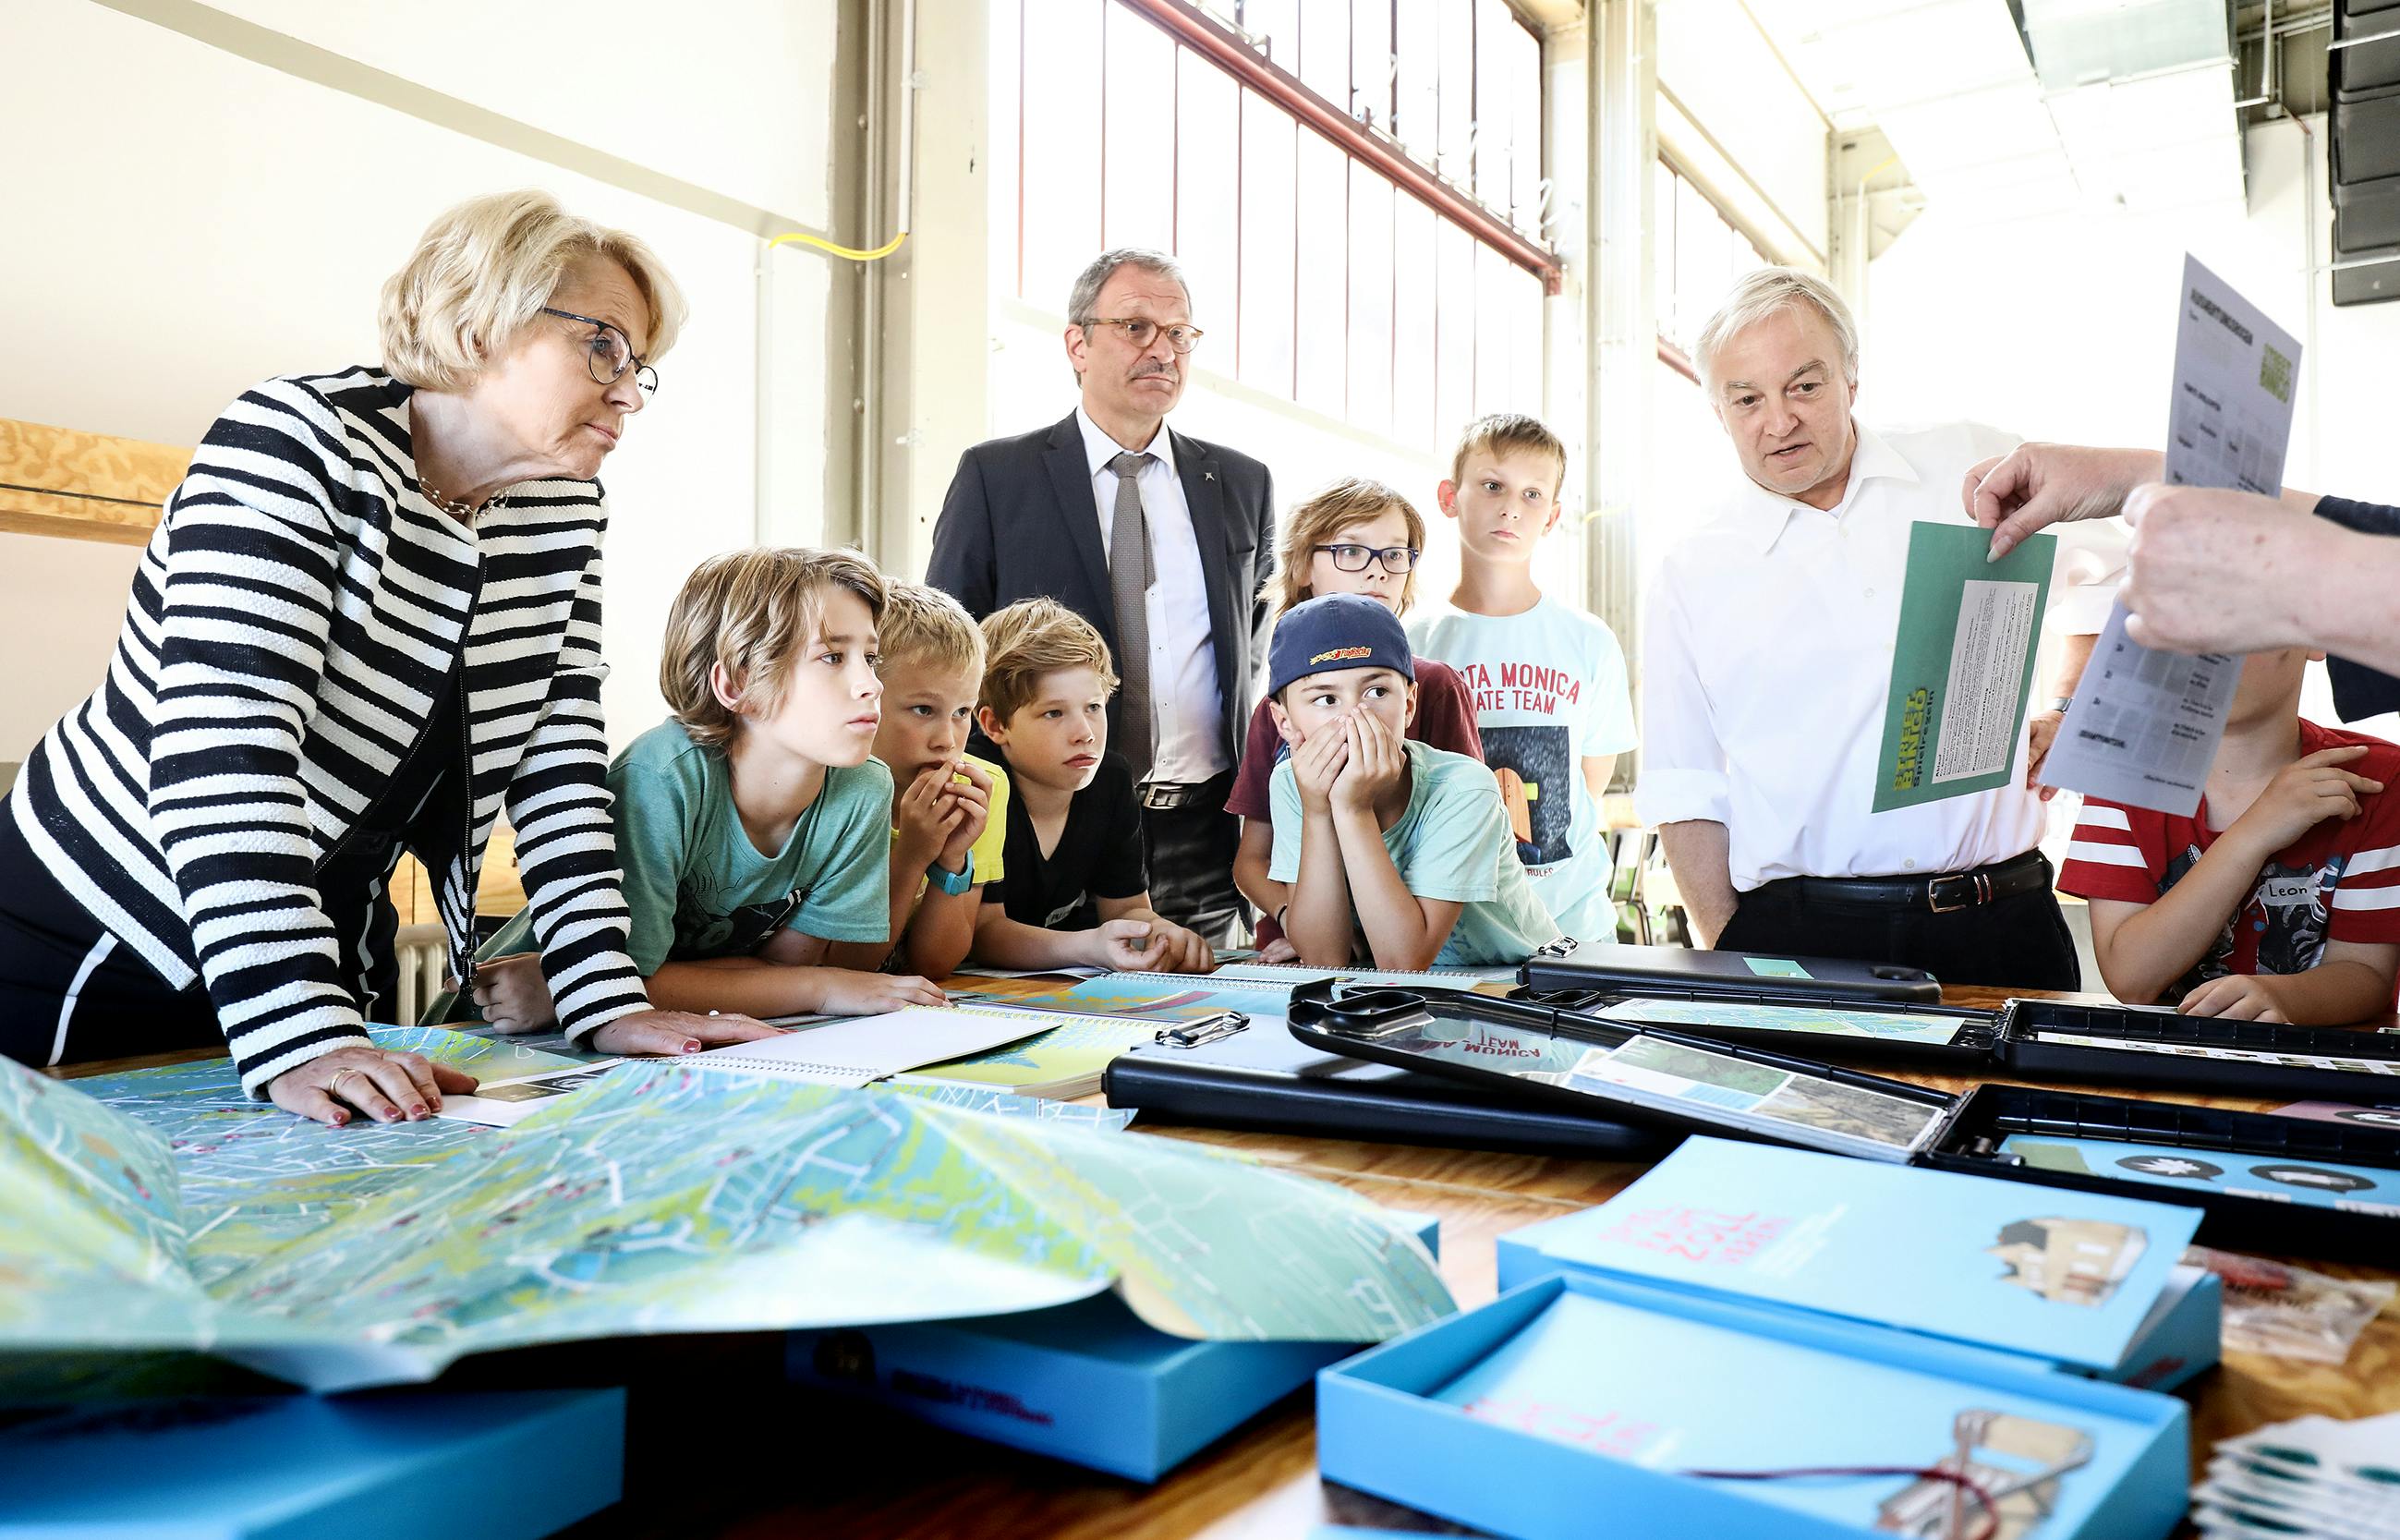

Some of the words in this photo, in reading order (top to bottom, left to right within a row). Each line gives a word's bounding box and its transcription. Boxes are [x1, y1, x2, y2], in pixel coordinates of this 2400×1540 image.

[1460, 664, 1491, 689] TA
[1501, 662, 1581, 705] MONICA
[1477, 690, 1505, 711] ATE
[1512, 689, 1556, 715] TEAM
[1978, 687, 1989, 730] Auswertung
[1893, 692, 1916, 791] STREET
[1900, 686, 1927, 790] BINGO
[1912, 690, 1935, 787] Spielregeln
[2269, 884, 2308, 897] Leon
